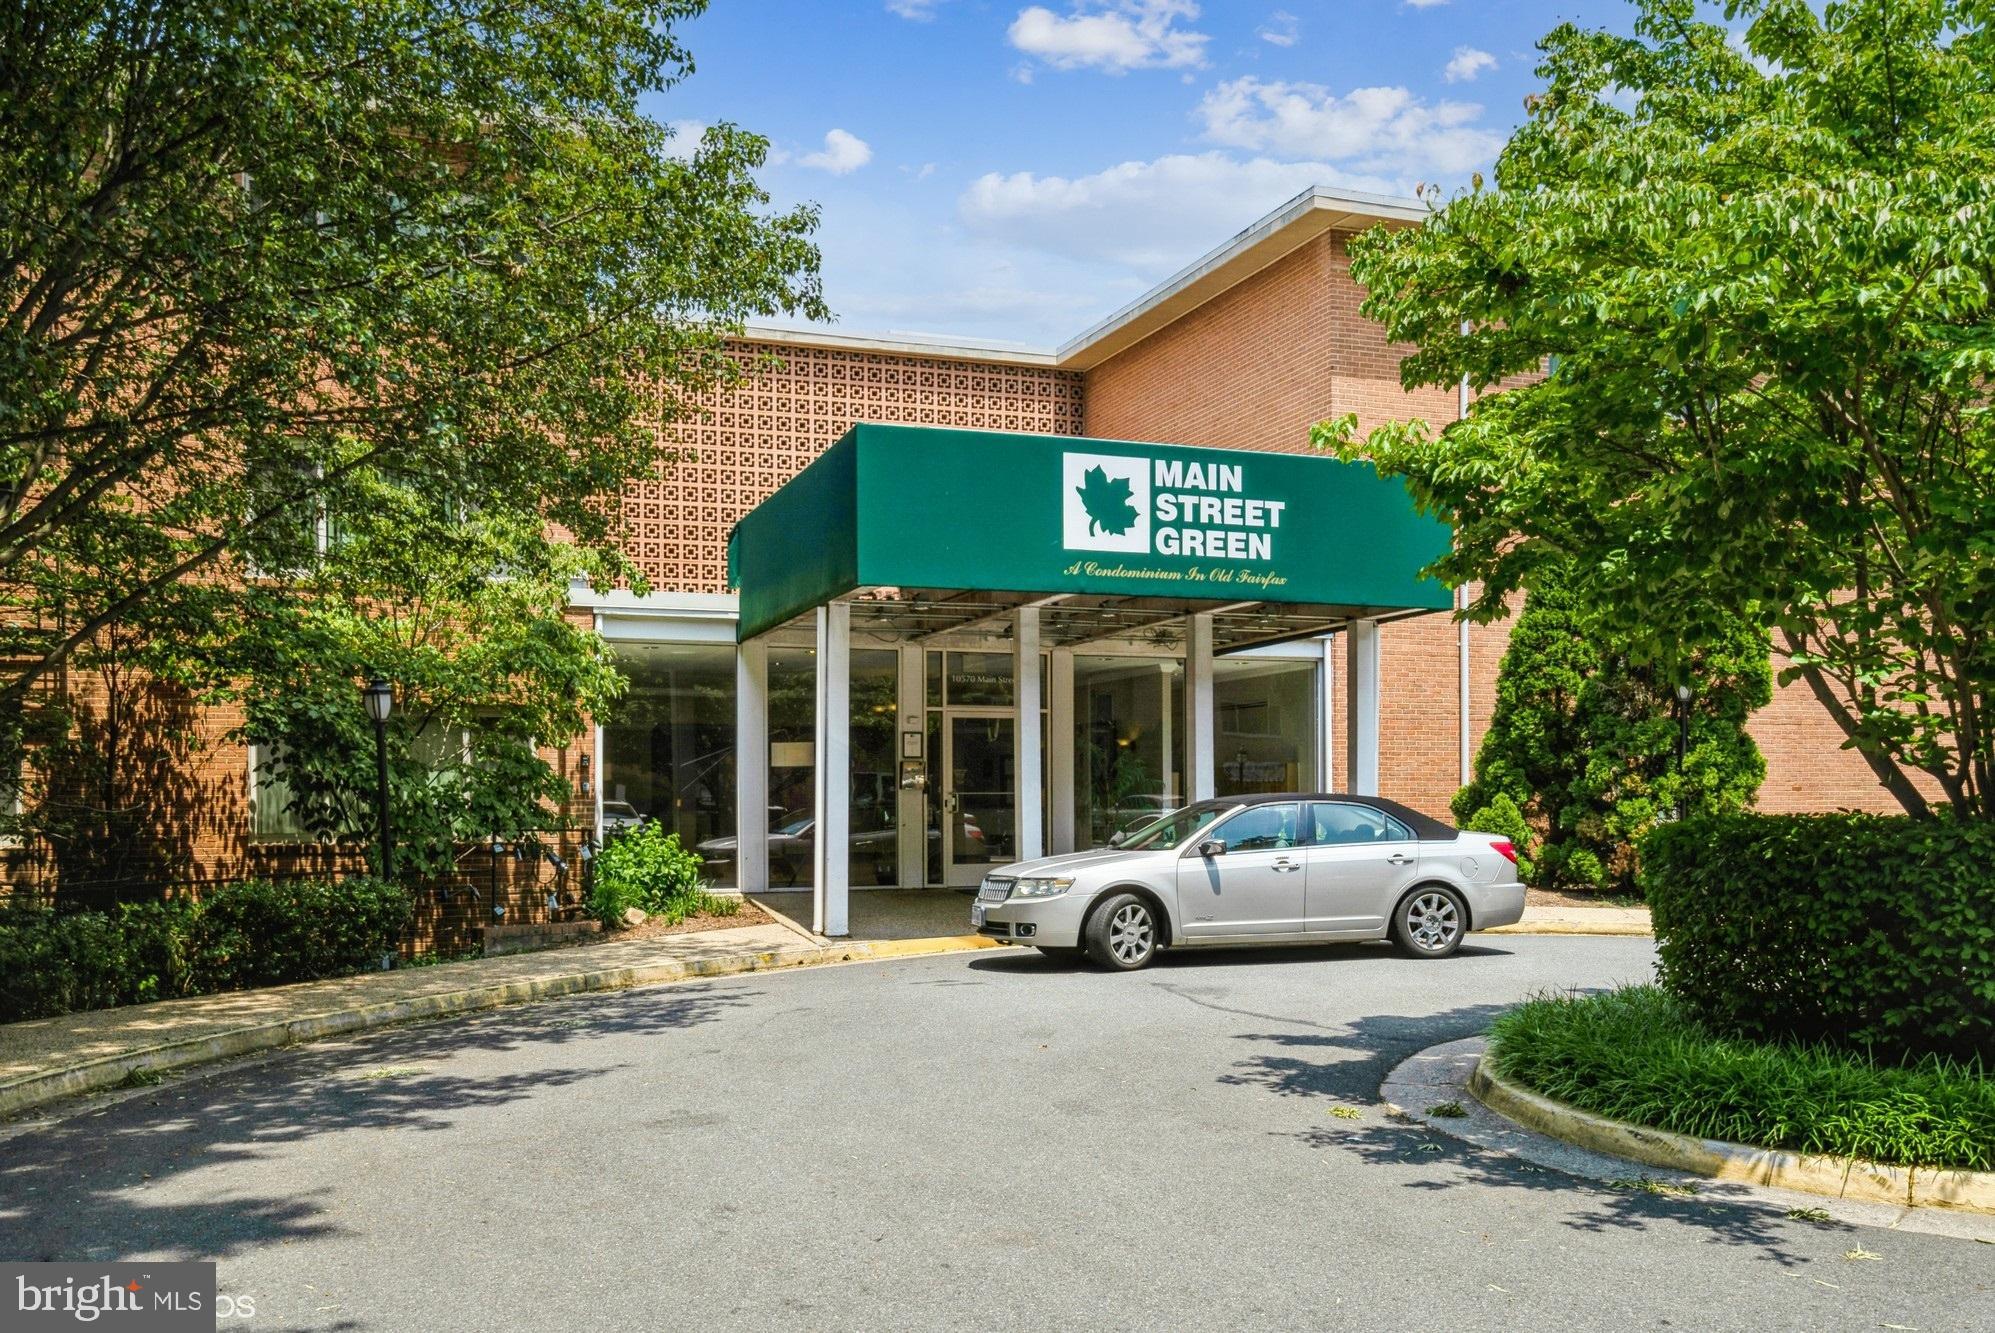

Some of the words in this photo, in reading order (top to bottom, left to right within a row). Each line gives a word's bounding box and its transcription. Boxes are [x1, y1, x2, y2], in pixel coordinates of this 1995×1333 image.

[1155, 460, 1242, 493] MAIN
[1156, 494, 1286, 528] STREET
[1155, 527, 1272, 560] GREEN
[1063, 560, 1082, 576] A
[1083, 561, 1183, 581] Condominium
[1184, 566, 1206, 581] In
[1209, 567, 1235, 583] Old
[1235, 569, 1289, 590] Fairfax
[977, 675, 998, 684] Main
[999, 676, 1015, 685] Stre
